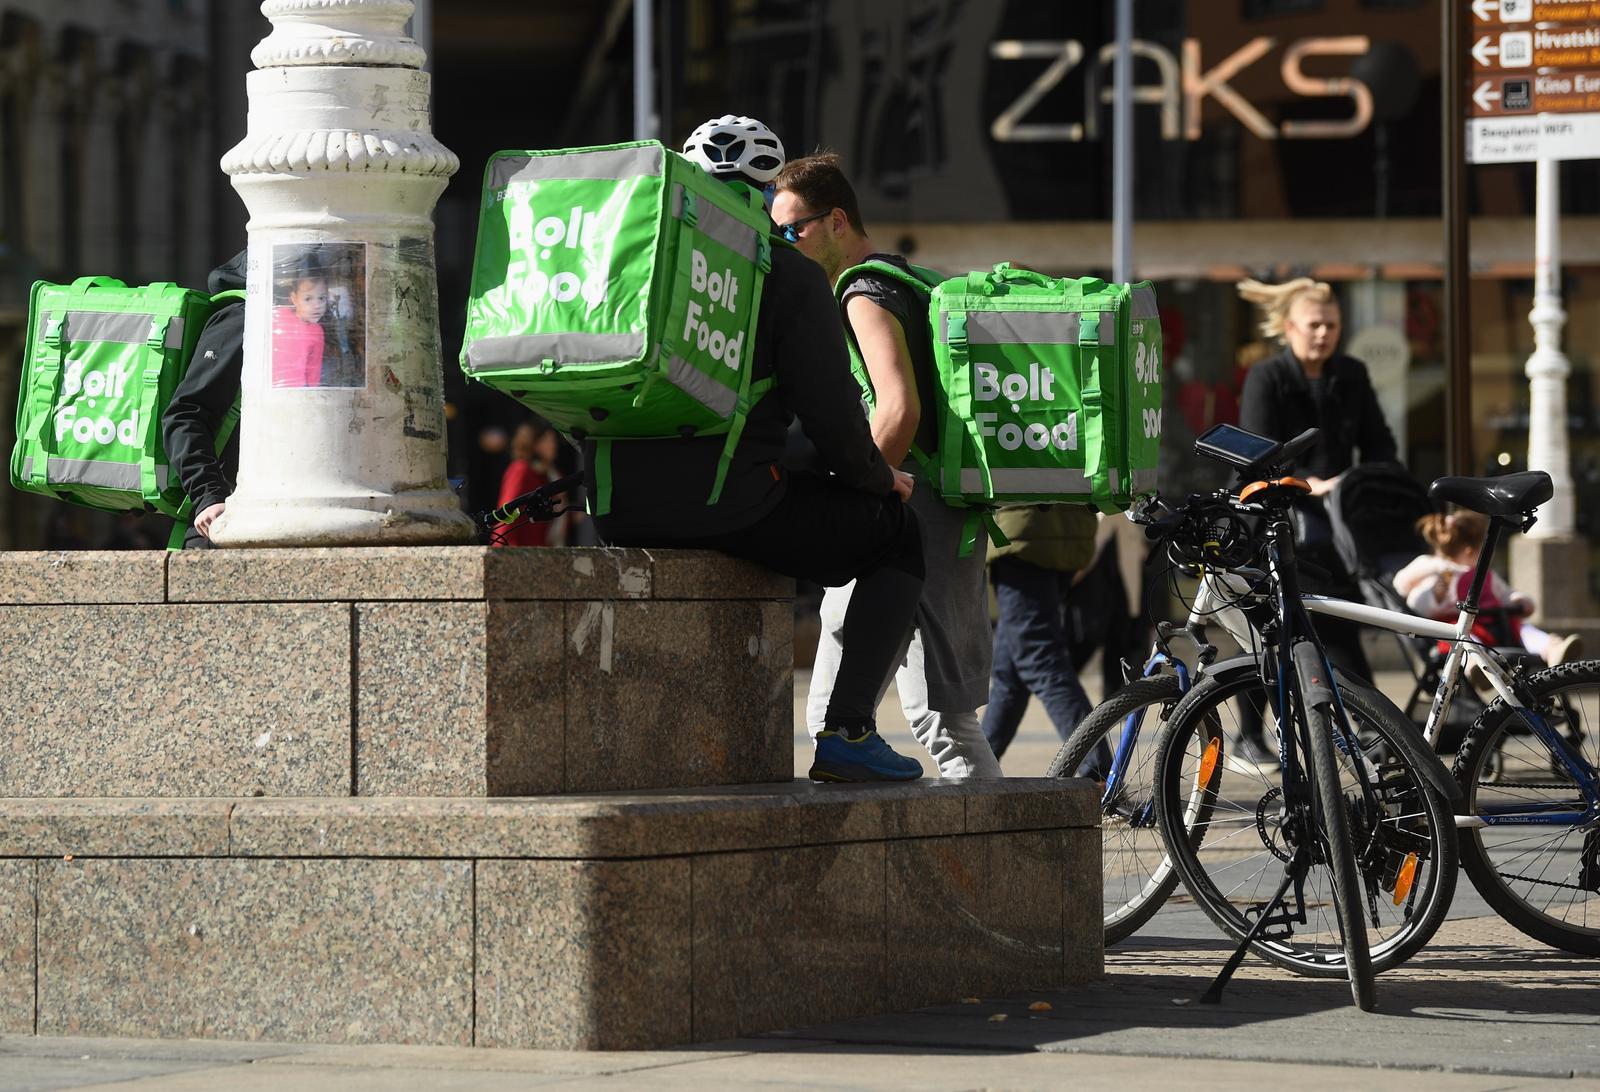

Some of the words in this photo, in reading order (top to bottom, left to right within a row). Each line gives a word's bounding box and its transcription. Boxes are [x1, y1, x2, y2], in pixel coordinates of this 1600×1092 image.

[991, 35, 1373, 141] ZAKS
[1535, 77, 1571, 94] Kino
[509, 206, 600, 250] Bolt
[690, 249, 739, 314] Bolt
[682, 301, 745, 371] Food
[60, 360, 128, 398] Bolt
[974, 362, 1055, 401] Bolt
[54, 405, 140, 446] Food
[974, 412, 1078, 451] Food
